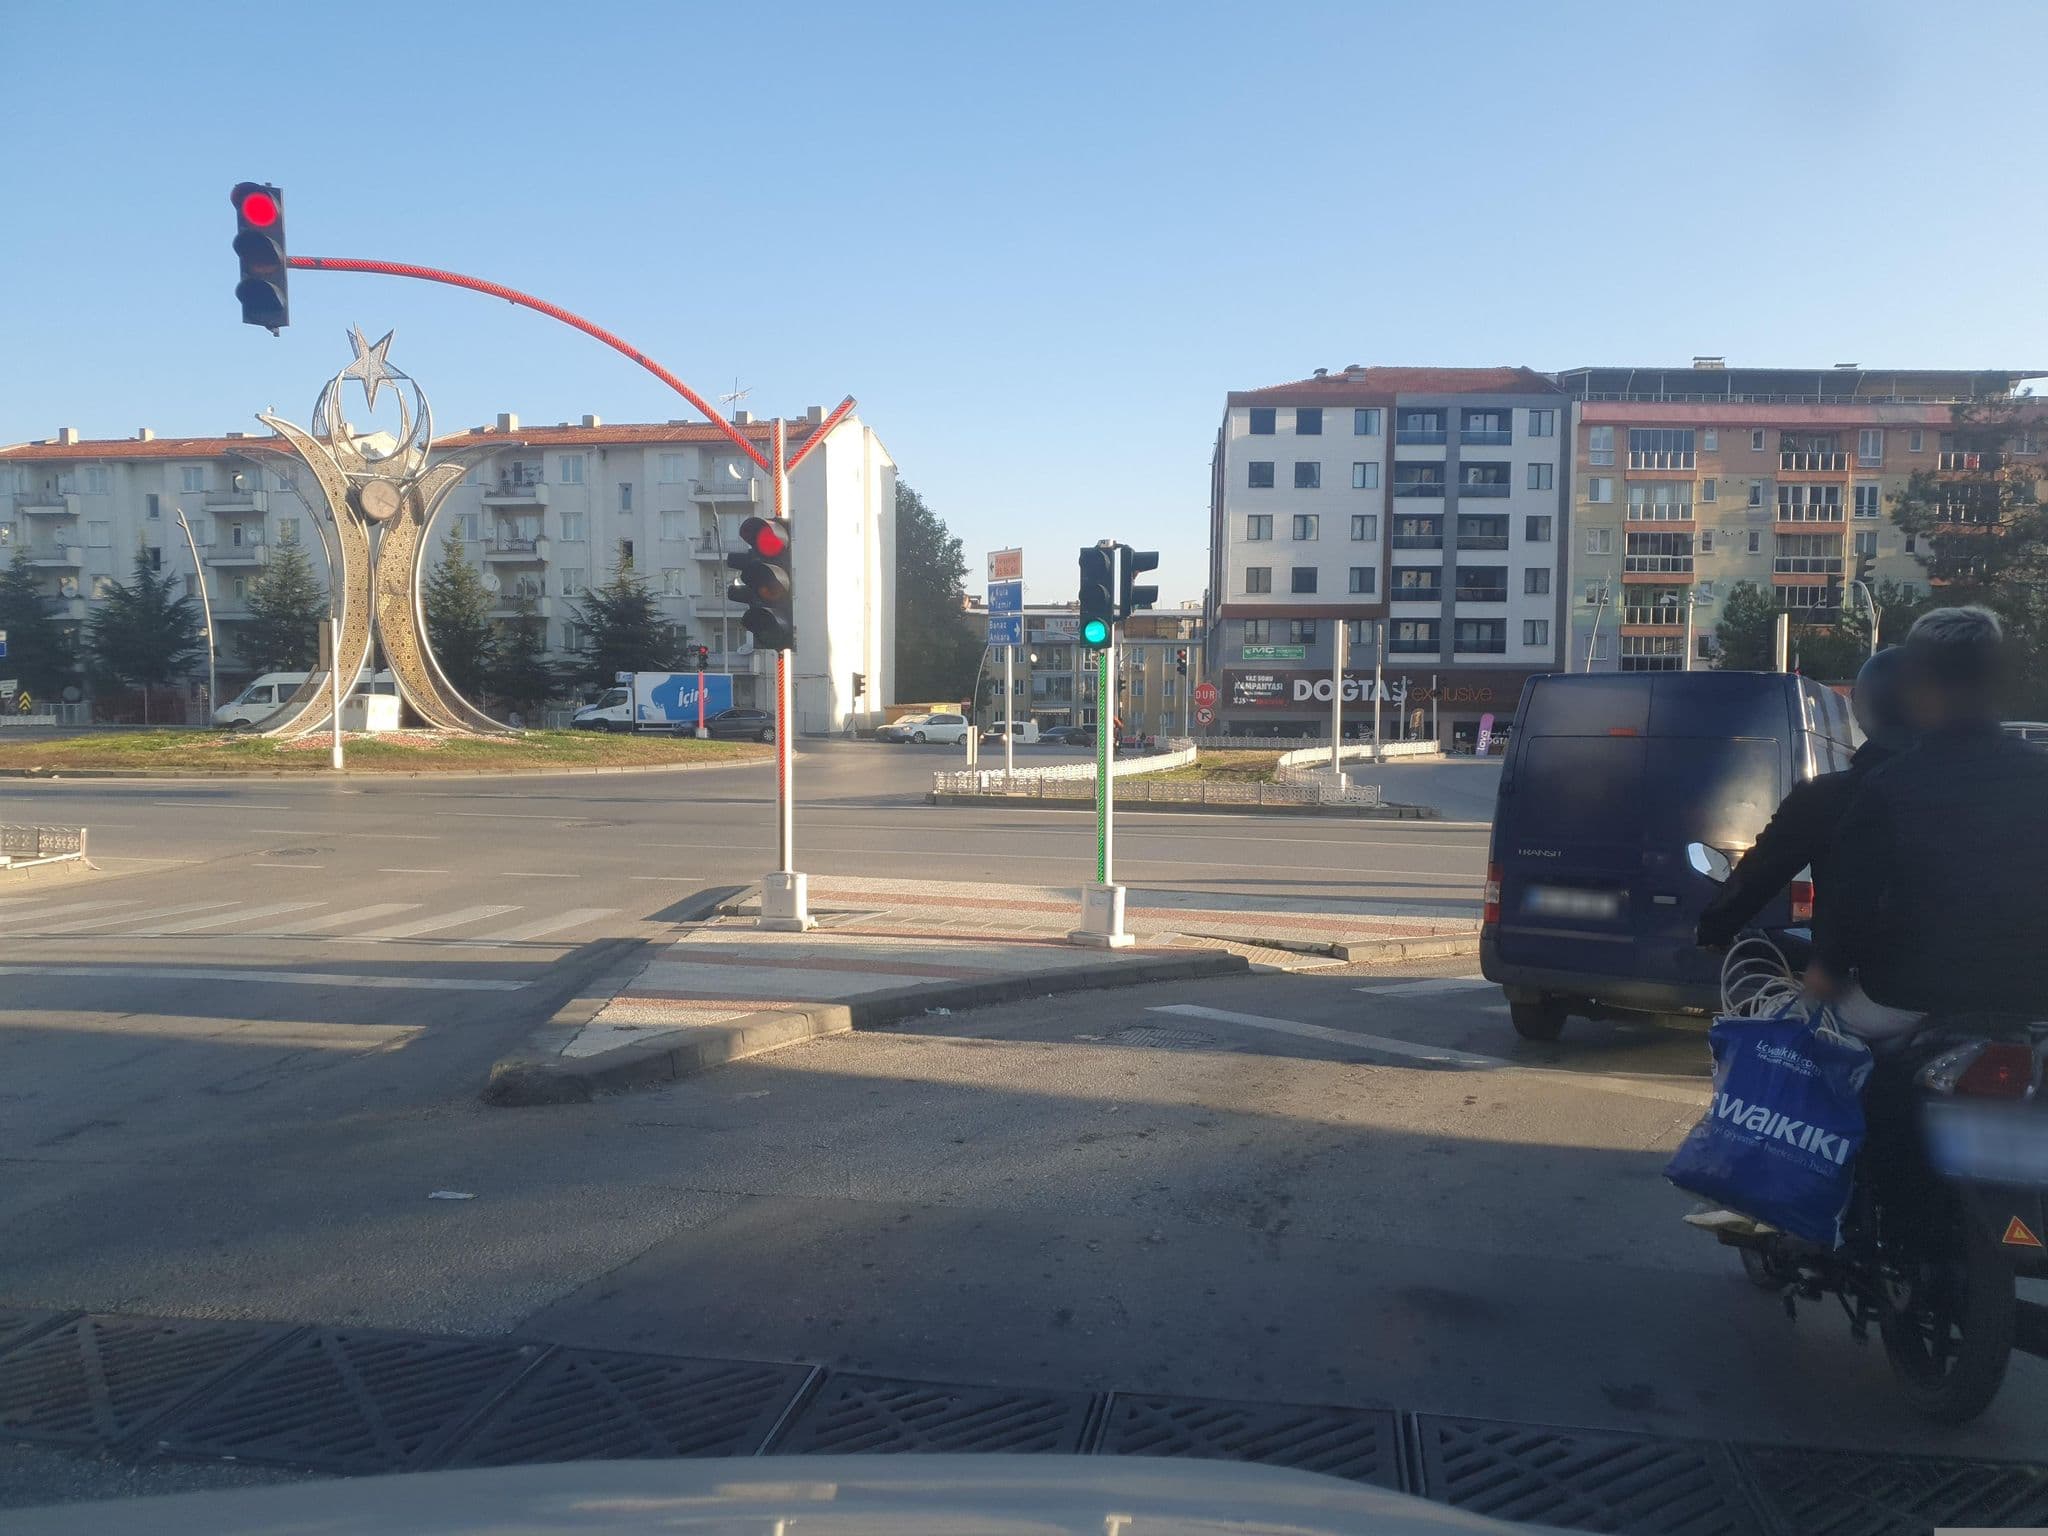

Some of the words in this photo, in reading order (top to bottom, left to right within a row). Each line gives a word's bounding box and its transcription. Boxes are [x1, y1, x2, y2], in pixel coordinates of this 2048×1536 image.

[1195, 690, 1215, 699] DUR
[1293, 674, 1408, 707] DOĞTAŞ
[1411, 687, 1493, 702] exlusive
